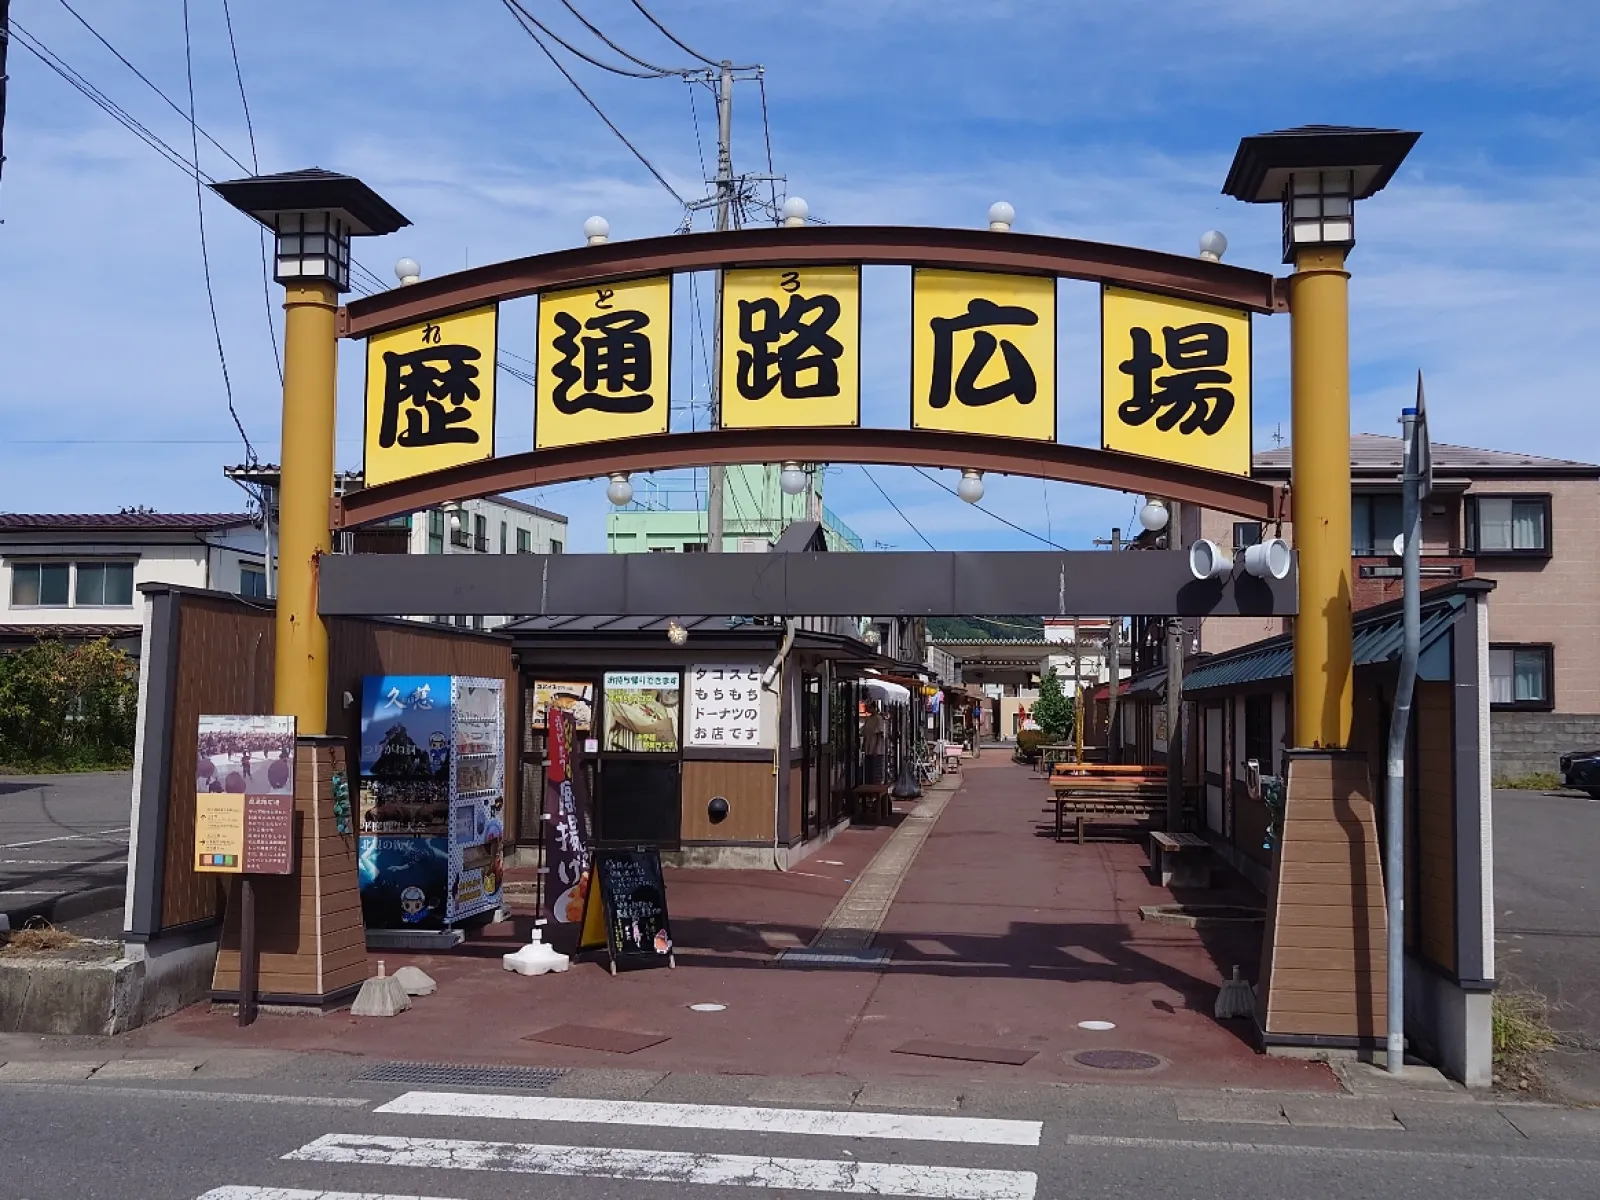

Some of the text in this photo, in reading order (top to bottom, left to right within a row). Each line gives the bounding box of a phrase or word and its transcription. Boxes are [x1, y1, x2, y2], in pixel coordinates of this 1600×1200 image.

[421, 272, 800, 345] れ と ろ
[607, 676, 677, 686] お持ち帰りできます
[696, 667, 758, 681] タコスと
[695, 687, 758, 701] もちもち
[695, 707, 758, 720] ドーナツの
[694, 726, 758, 740] お店です
